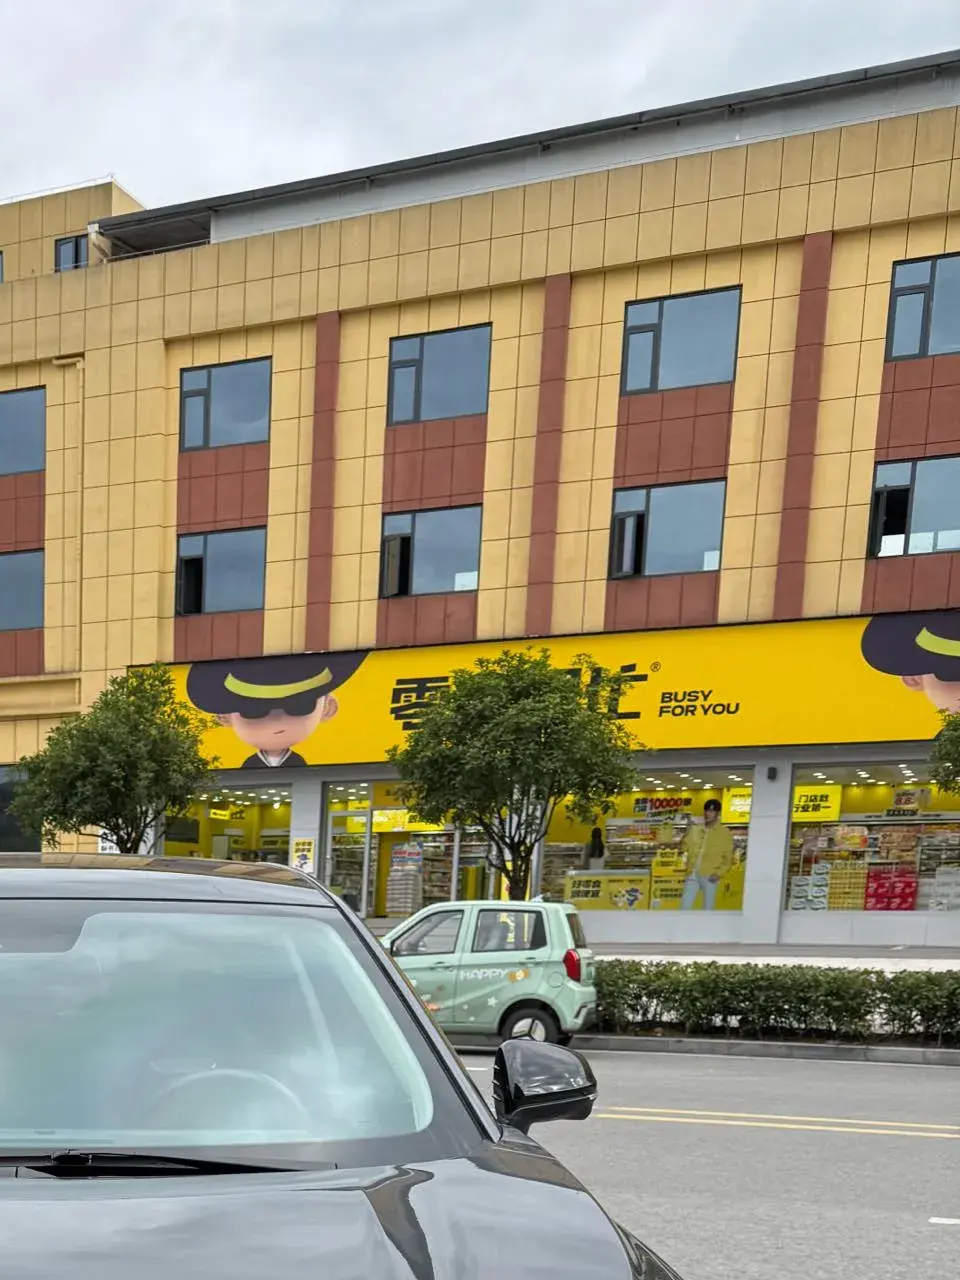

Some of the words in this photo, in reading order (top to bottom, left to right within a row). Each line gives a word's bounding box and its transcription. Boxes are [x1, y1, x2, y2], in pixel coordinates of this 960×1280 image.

[661, 690, 713, 704] BUSY
[659, 704, 696, 718] FOR
[702, 702, 741, 715] YOU
[460, 968, 507, 980] HAPPY
